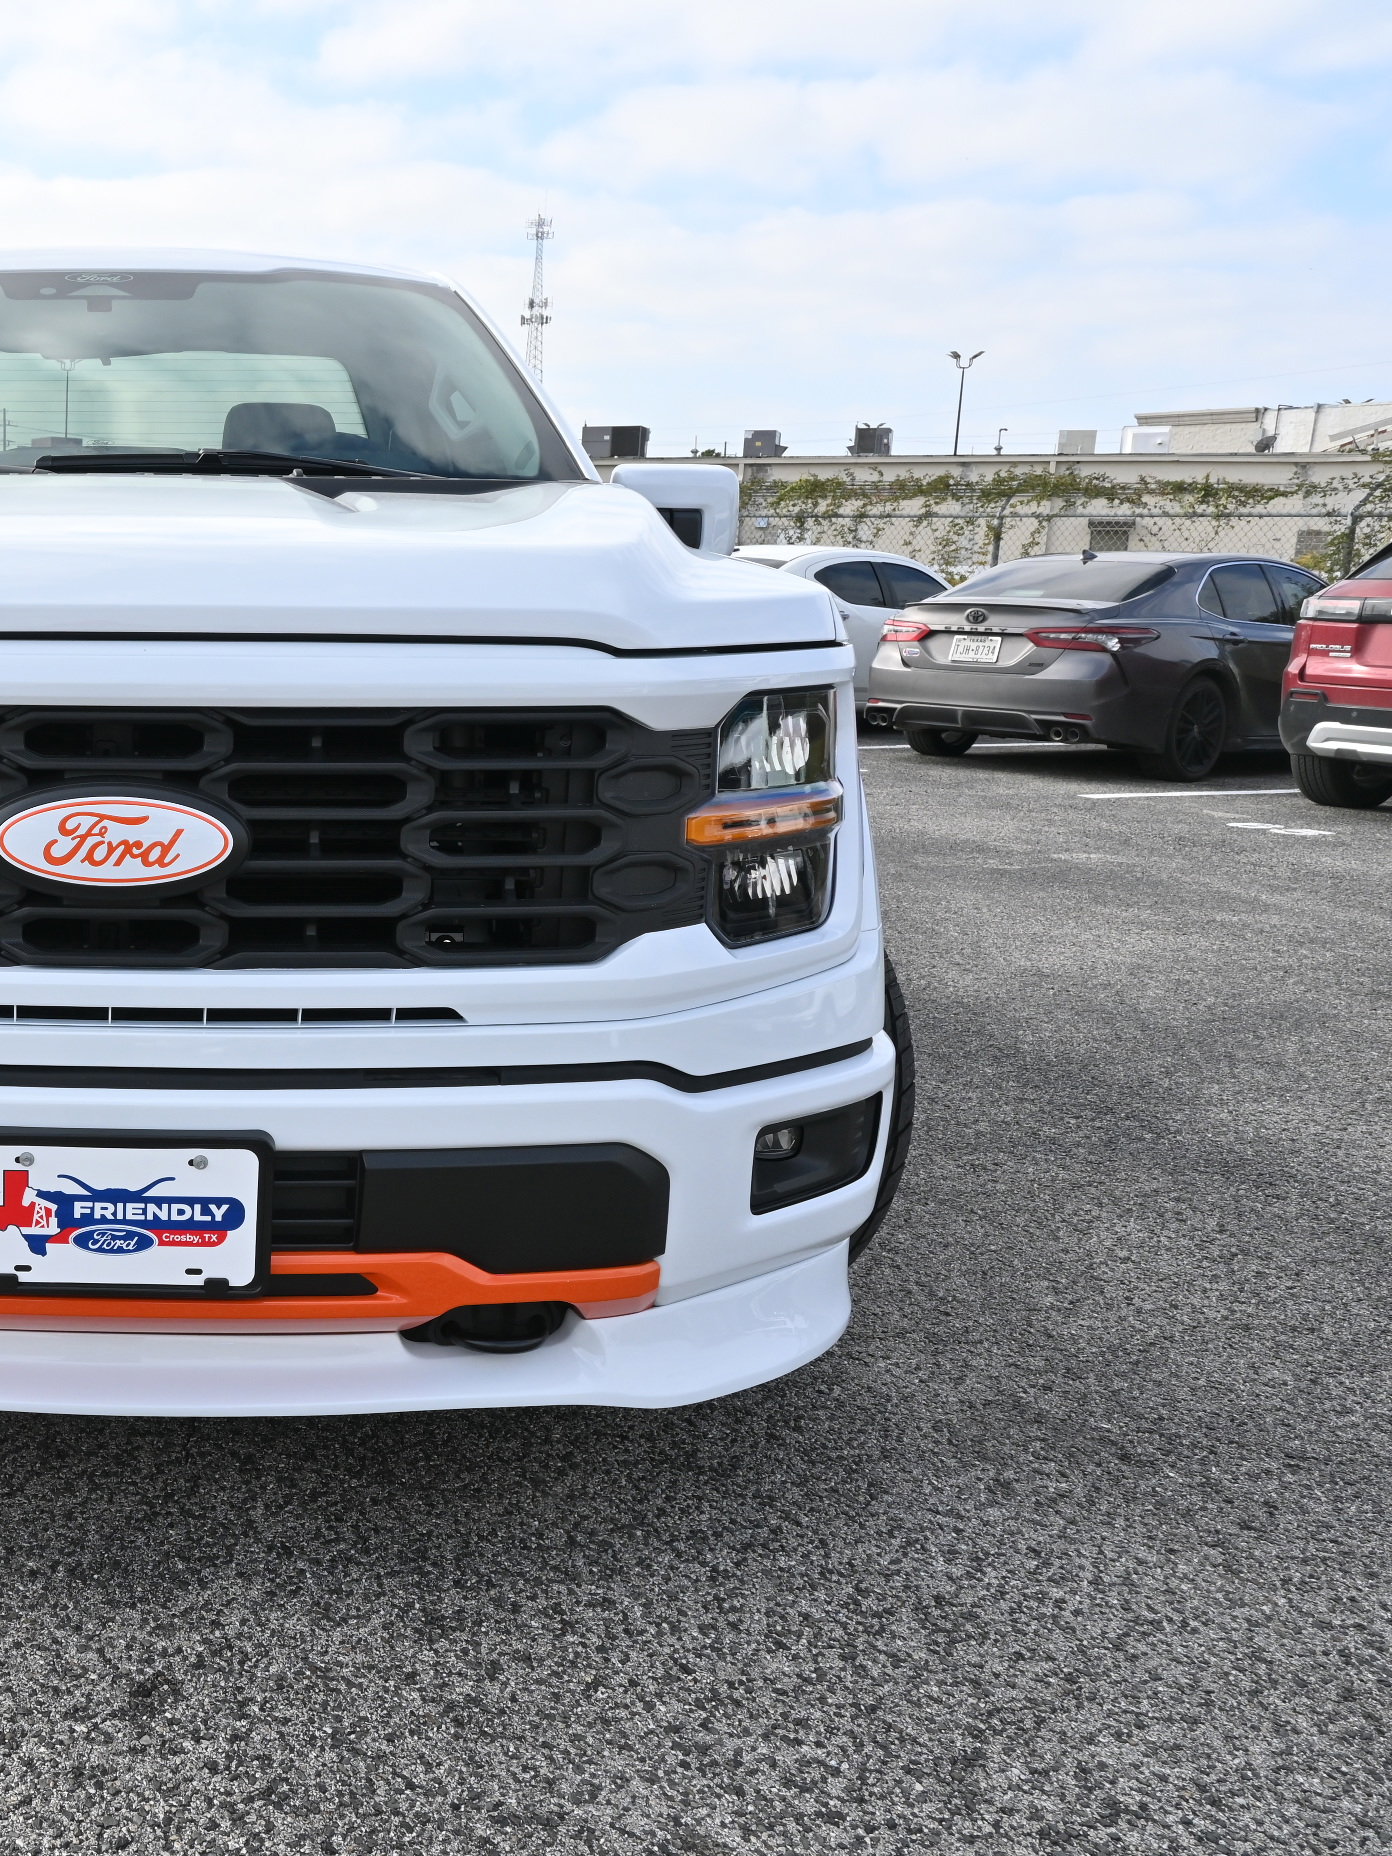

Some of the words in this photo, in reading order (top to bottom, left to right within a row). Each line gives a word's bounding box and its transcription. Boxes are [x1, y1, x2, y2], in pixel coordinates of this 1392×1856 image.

[77, 273, 121, 281] Ford
[43, 811, 185, 868] Ford
[73, 1201, 230, 1222] FRIENDLY
[87, 1230, 139, 1251] Ford
[162, 1233, 202, 1244] Crosby,
[203, 1234, 219, 1243] TX
